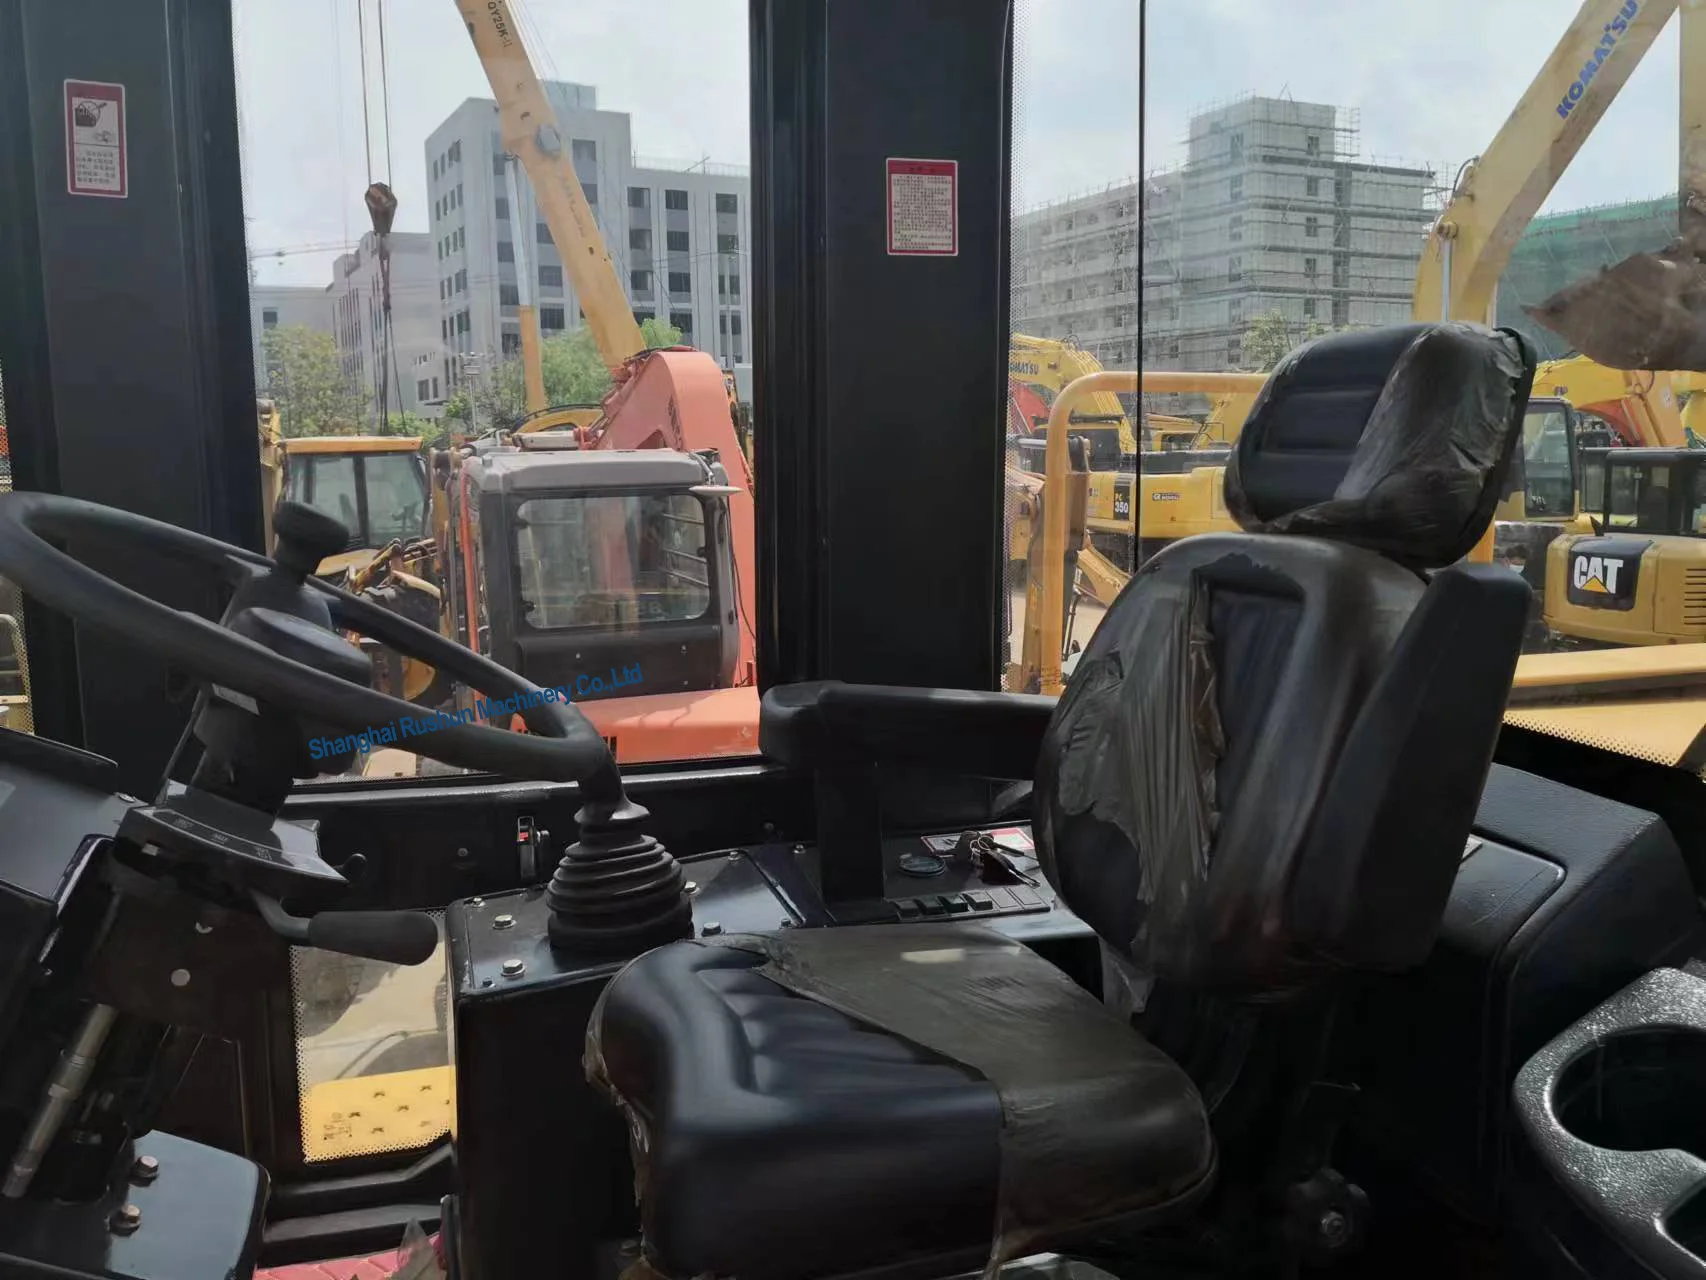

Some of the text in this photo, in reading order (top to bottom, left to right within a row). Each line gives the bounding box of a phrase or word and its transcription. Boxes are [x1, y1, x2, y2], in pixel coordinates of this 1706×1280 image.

[1556, 0, 1637, 120] KOMATSU
[1114, 501, 1129, 513] 350
[1573, 555, 1624, 594] CAT
